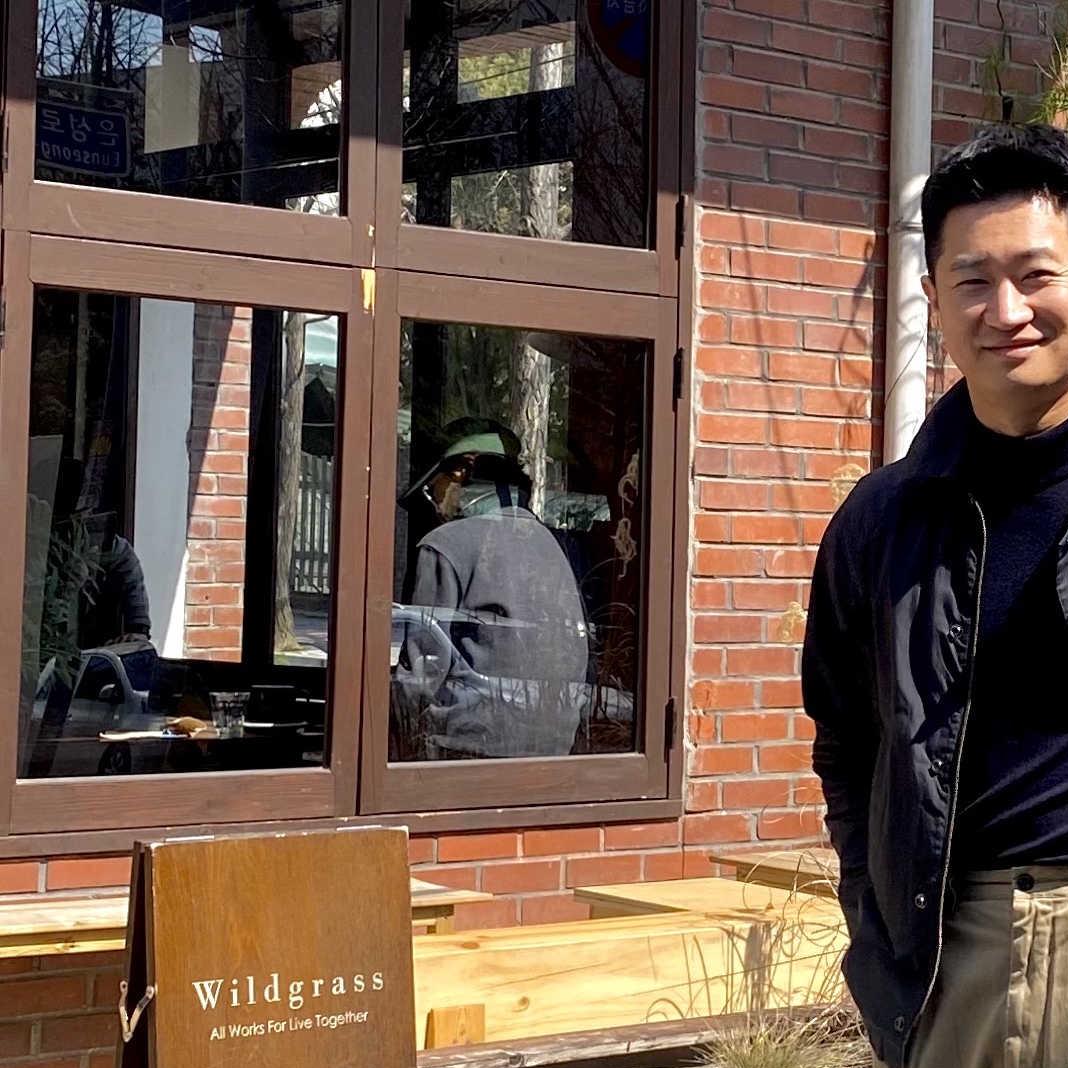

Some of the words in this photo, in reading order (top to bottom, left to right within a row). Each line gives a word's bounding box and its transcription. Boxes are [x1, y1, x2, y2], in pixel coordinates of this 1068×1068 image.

[191, 972, 385, 1011] Wildgrass
[210, 1027, 226, 1041] All
[229, 1022, 265, 1038] Works
[267, 1019, 287, 1033] For
[289, 1016, 313, 1031] Live
[315, 1010, 369, 1029] Together
